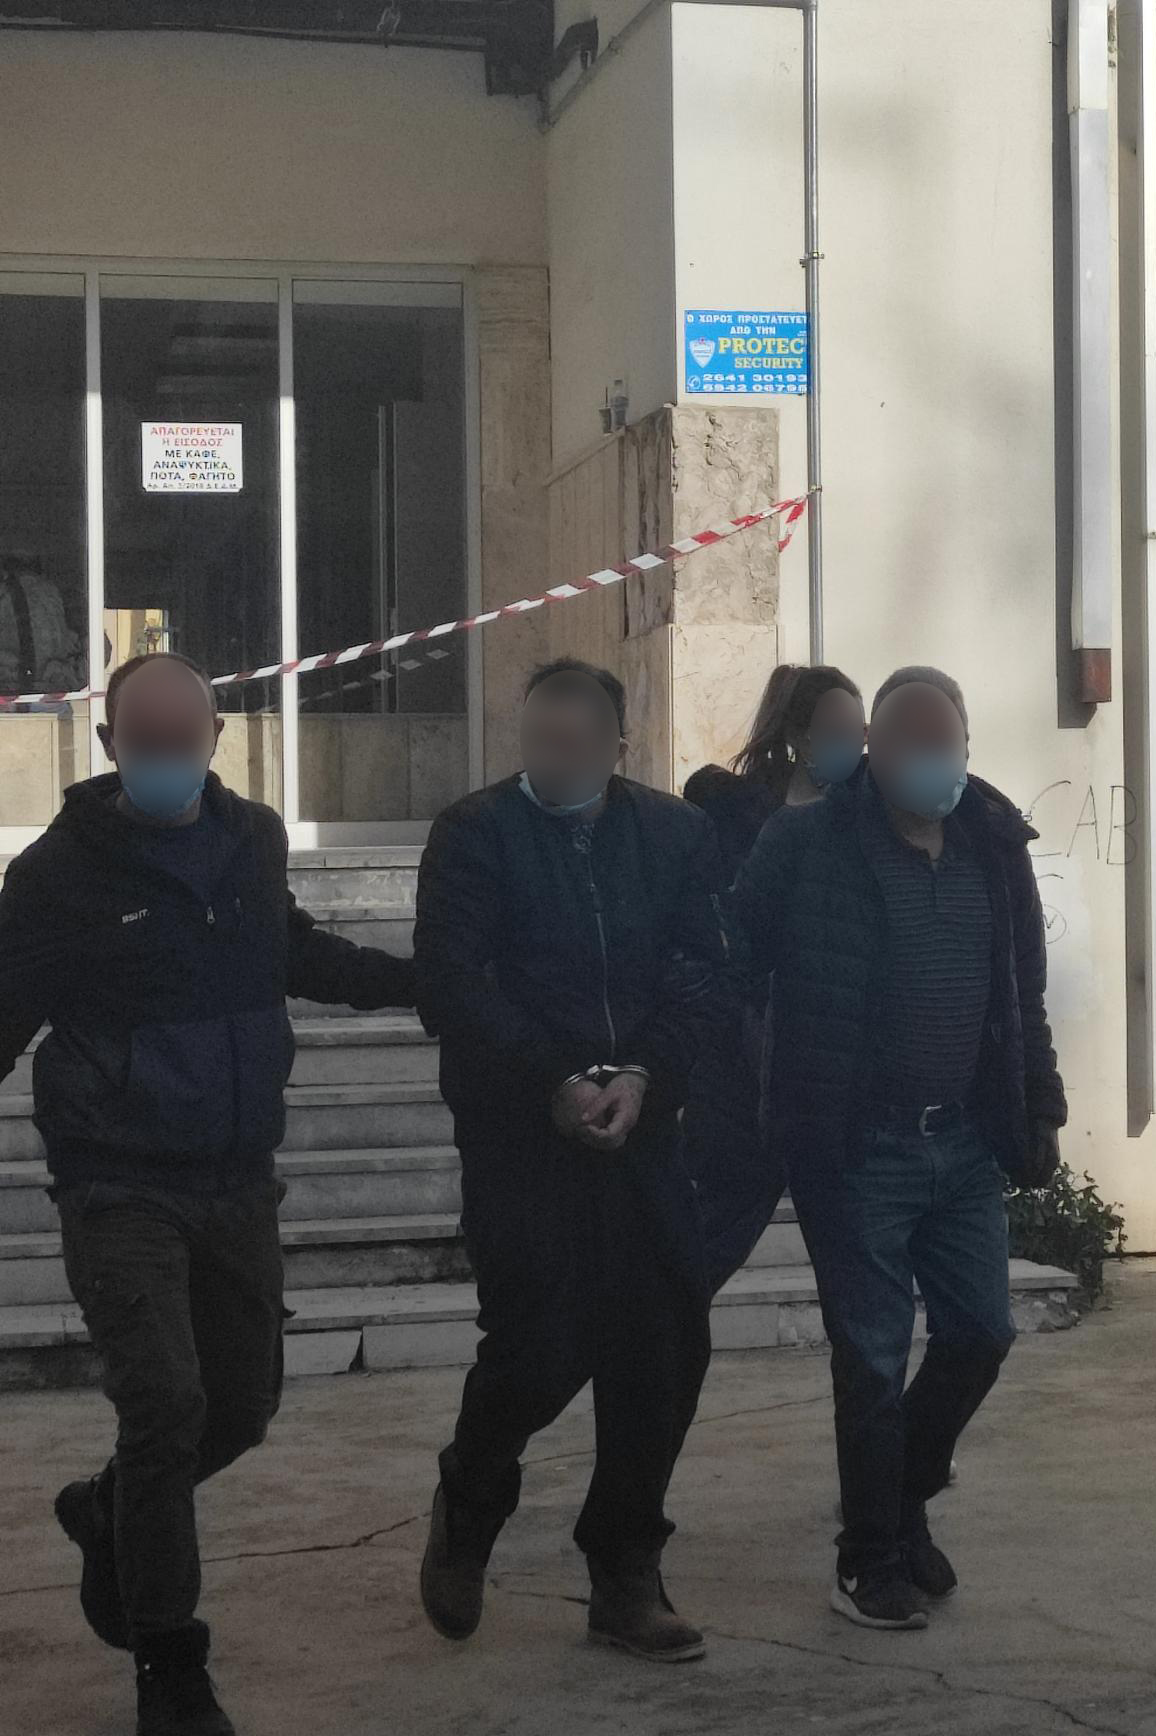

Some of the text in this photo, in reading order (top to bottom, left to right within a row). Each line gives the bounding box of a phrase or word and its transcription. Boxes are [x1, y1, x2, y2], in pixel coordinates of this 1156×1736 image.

[699, 315, 733, 323] ΧΩΡΟΣ
[755, 325, 776, 335] ΤΗΝ
[735, 357, 803, 368] SECURITY
[150, 426, 234, 436] ΑΠΑΓΟΡΕΥΕΤΑΙ
[162, 438, 223, 447] Η ΕΙΣΟΔΟΣ
[165, 449, 220, 459] ΜΕ ΚΑΦΕ,
[153, 461, 232, 470] ΑΝΑΨΥΚΤΙΚΑ,
[150, 472, 236, 481] ΠΟΤΑ, ΦΑΓΗΤΟ
